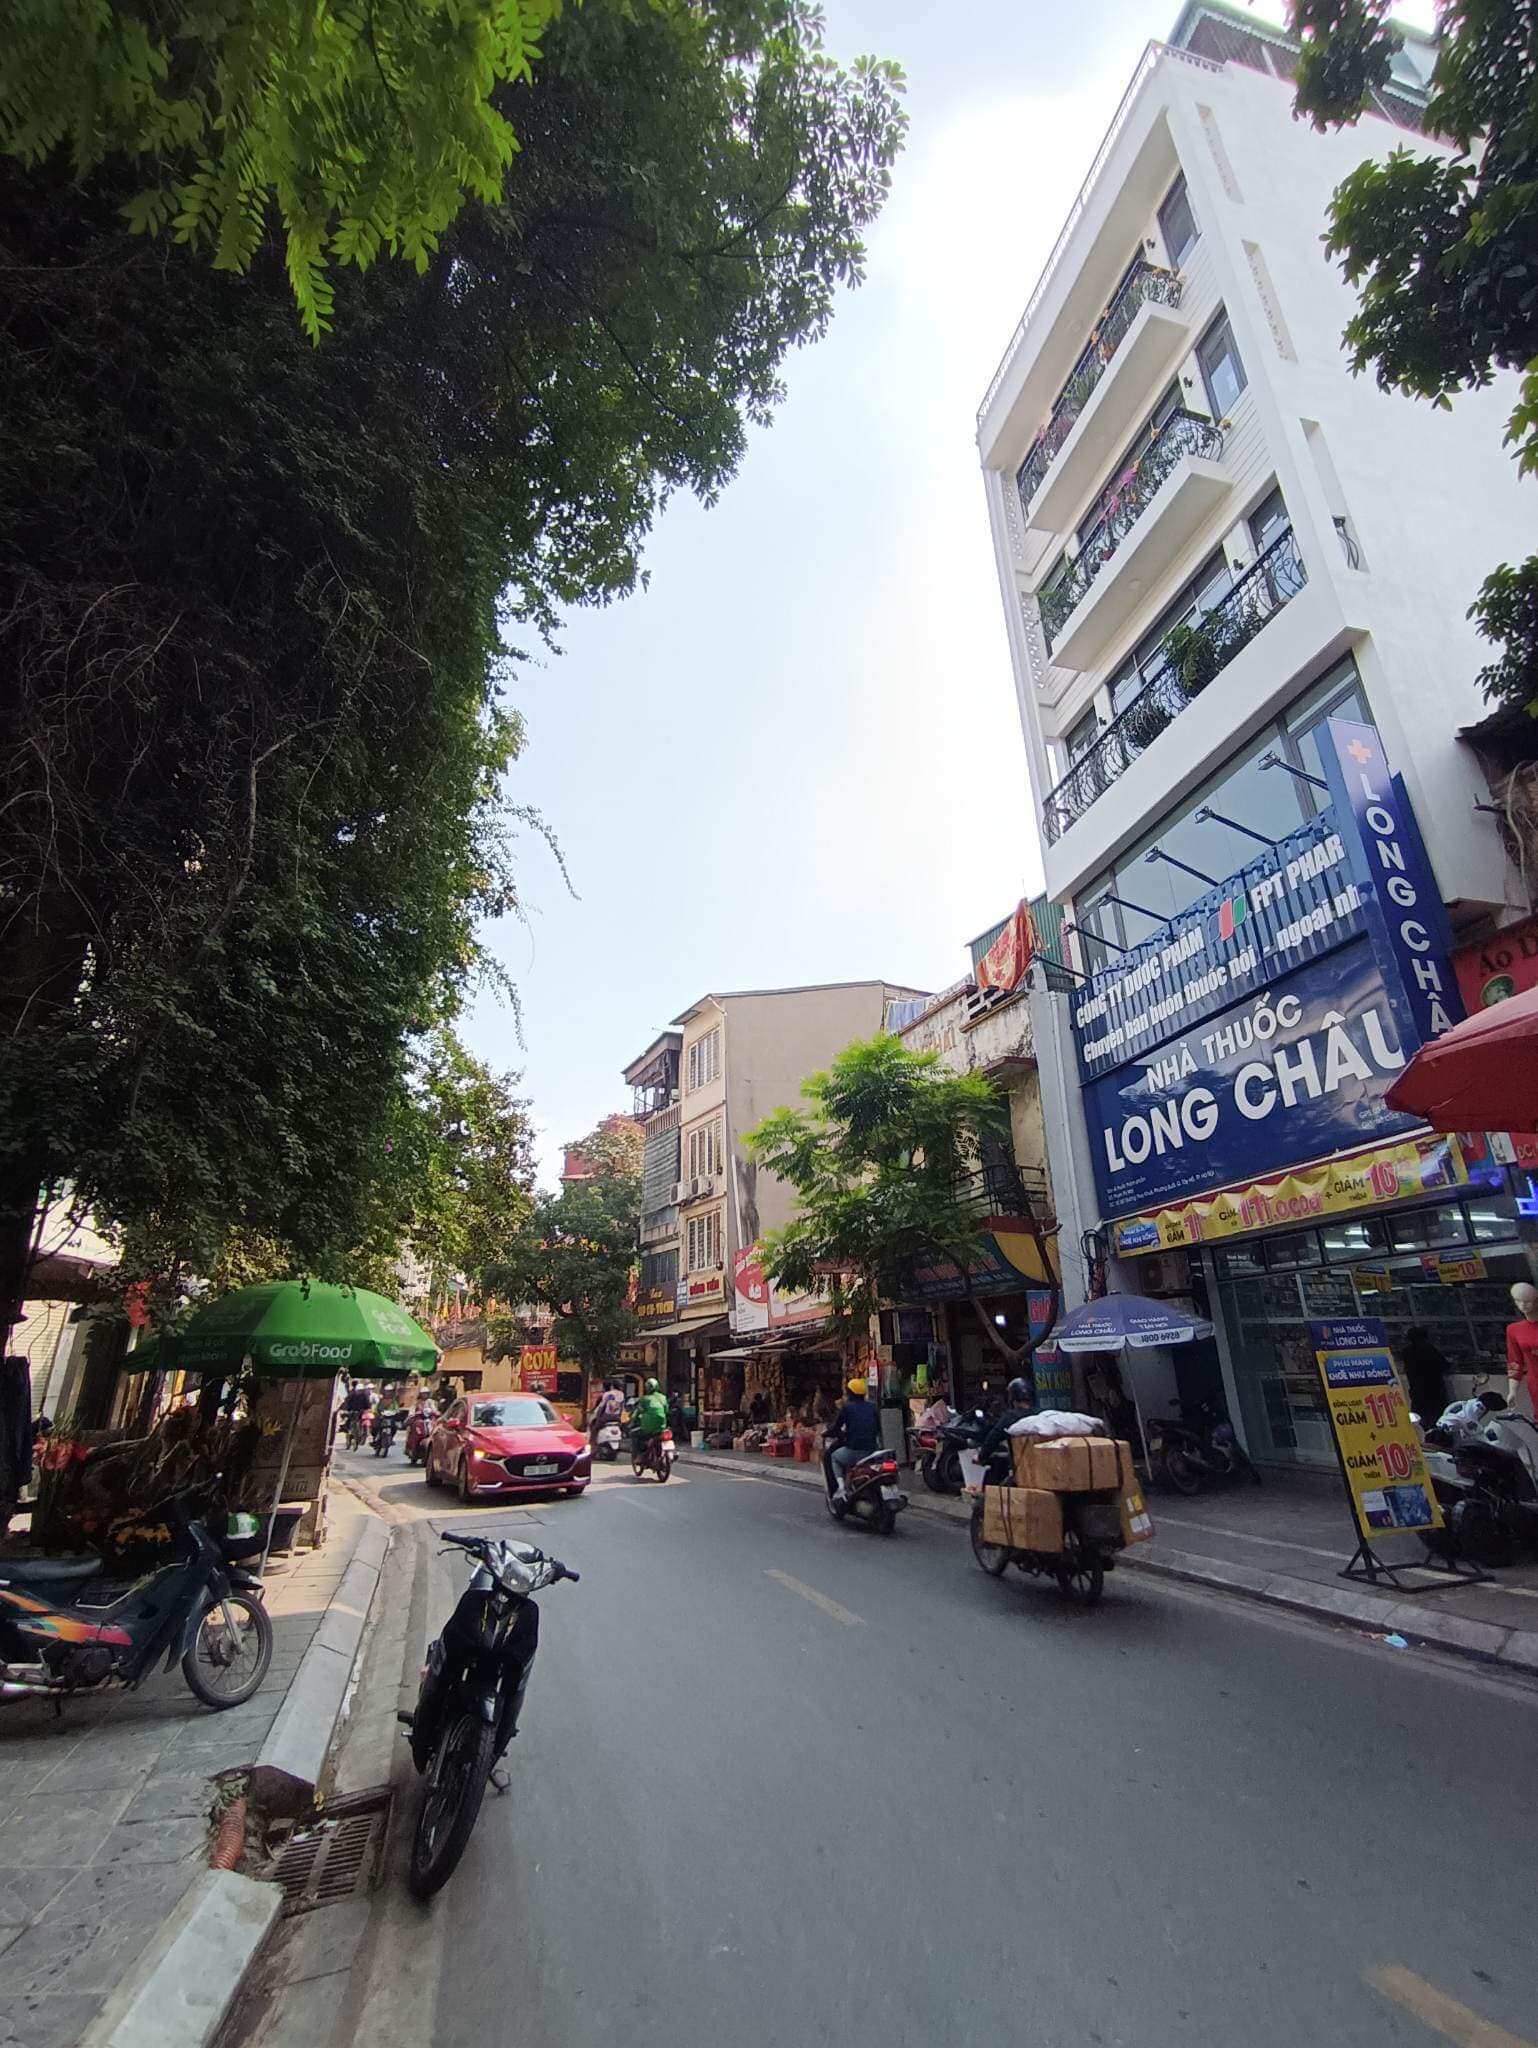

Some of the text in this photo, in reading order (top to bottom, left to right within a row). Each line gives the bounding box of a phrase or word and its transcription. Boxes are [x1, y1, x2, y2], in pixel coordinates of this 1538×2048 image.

[1360, 773, 1454, 1034] LONG CHÂ
[1076, 993, 1109, 1029] CÔNG
[1107, 979, 1124, 1007] TY
[1250, 877, 1286, 914] FPT
[1286, 833, 1346, 889] PHAR
[1184, 964, 1228, 1005] thuốc
[1333, 882, 1364, 919] nh
[1147, 990, 1303, 1094] NHÀ THUỐC
[1103, 1009, 1407, 1173] LONG CHÂU
[1141, 1333, 1160, 1343] 1800
[1335, 1336, 1358, 1346] LONG
[1357, 1332, 1379, 1344] CHÂU
[269, 1342, 352, 1360] GrabFood
[522, 1350, 556, 1371] CƠM
[1336, 1408, 1368, 1426] GIẢM
[1347, 1450, 1378, 1469] GIẢM
